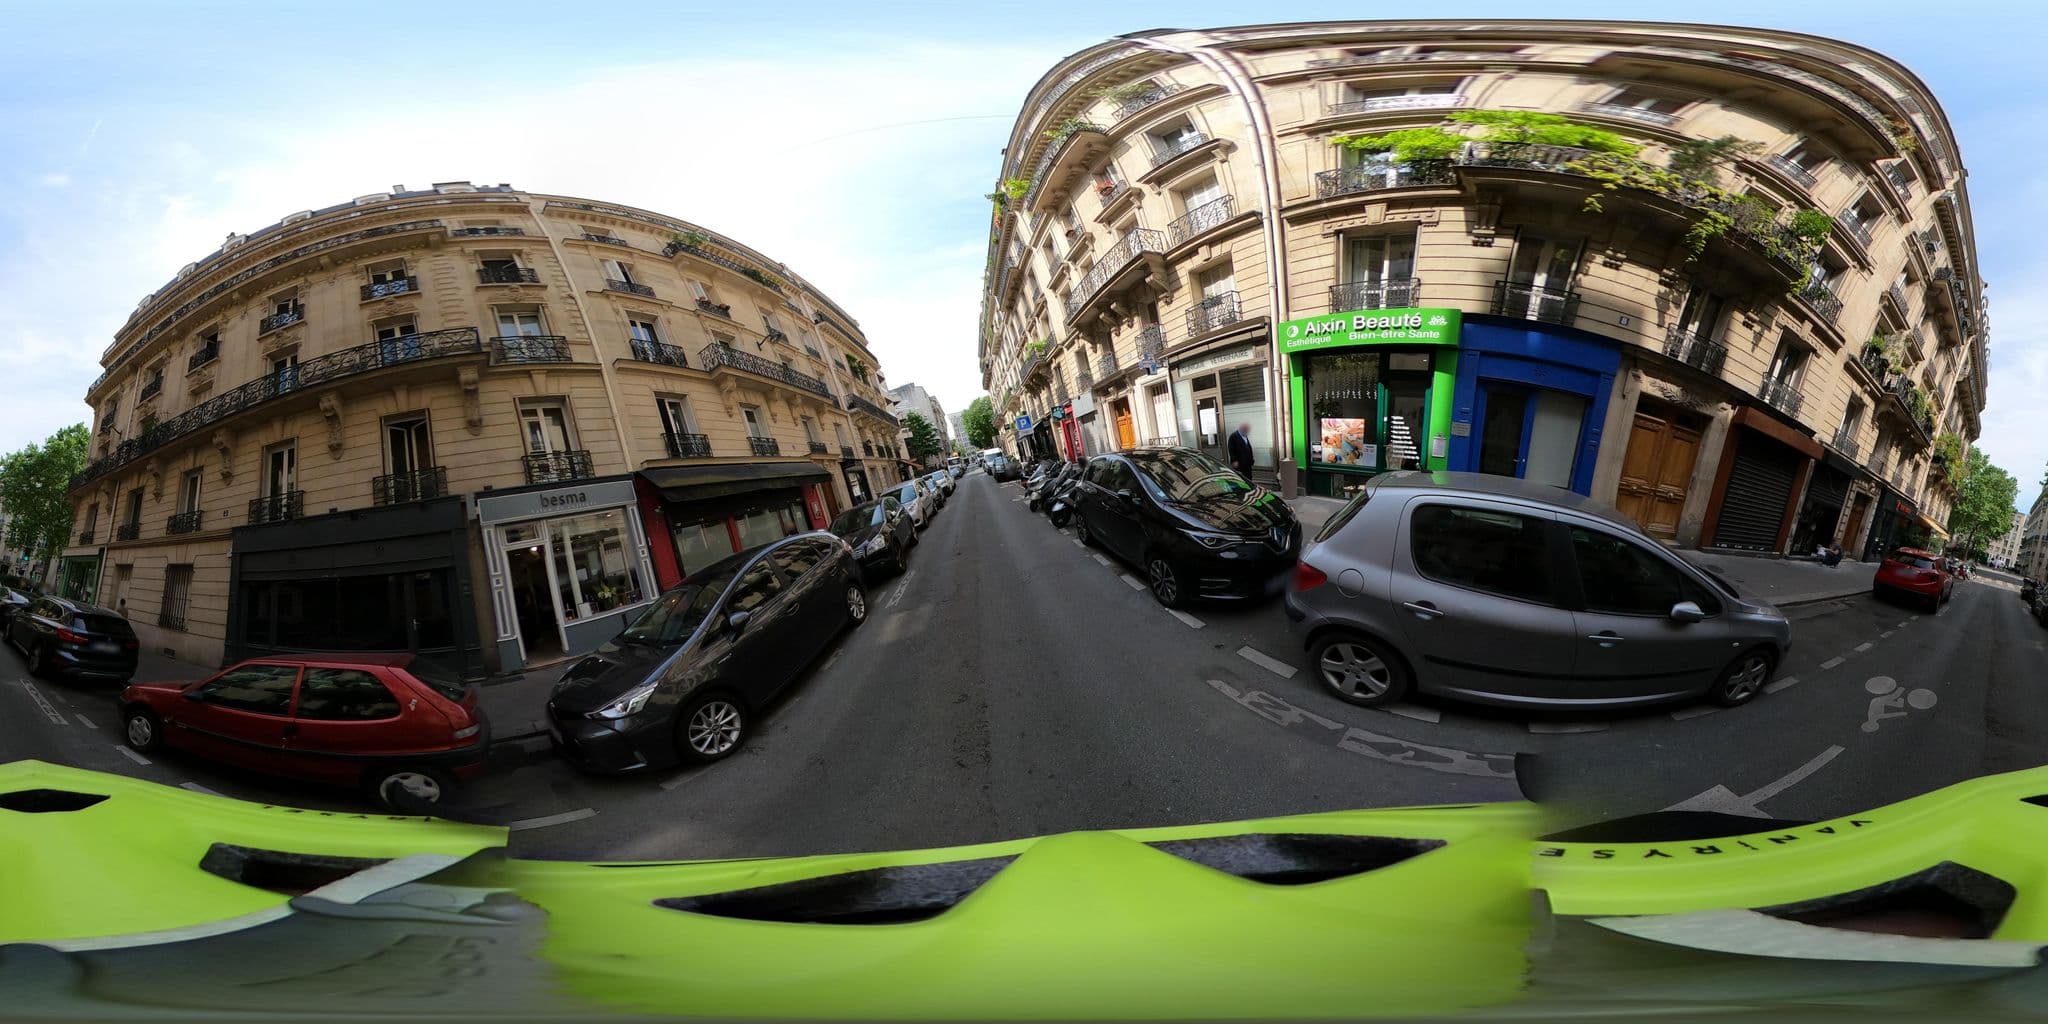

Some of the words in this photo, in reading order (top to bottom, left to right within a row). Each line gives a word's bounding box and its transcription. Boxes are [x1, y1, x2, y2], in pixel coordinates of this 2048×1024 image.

[1304, 318, 1346, 335] Aixin
[1353, 313, 1422, 330] Beauté
[1286, 336, 1332, 348] Esthétique
[1348, 330, 1406, 341] Bien-être
[539, 492, 587, 508] besma
